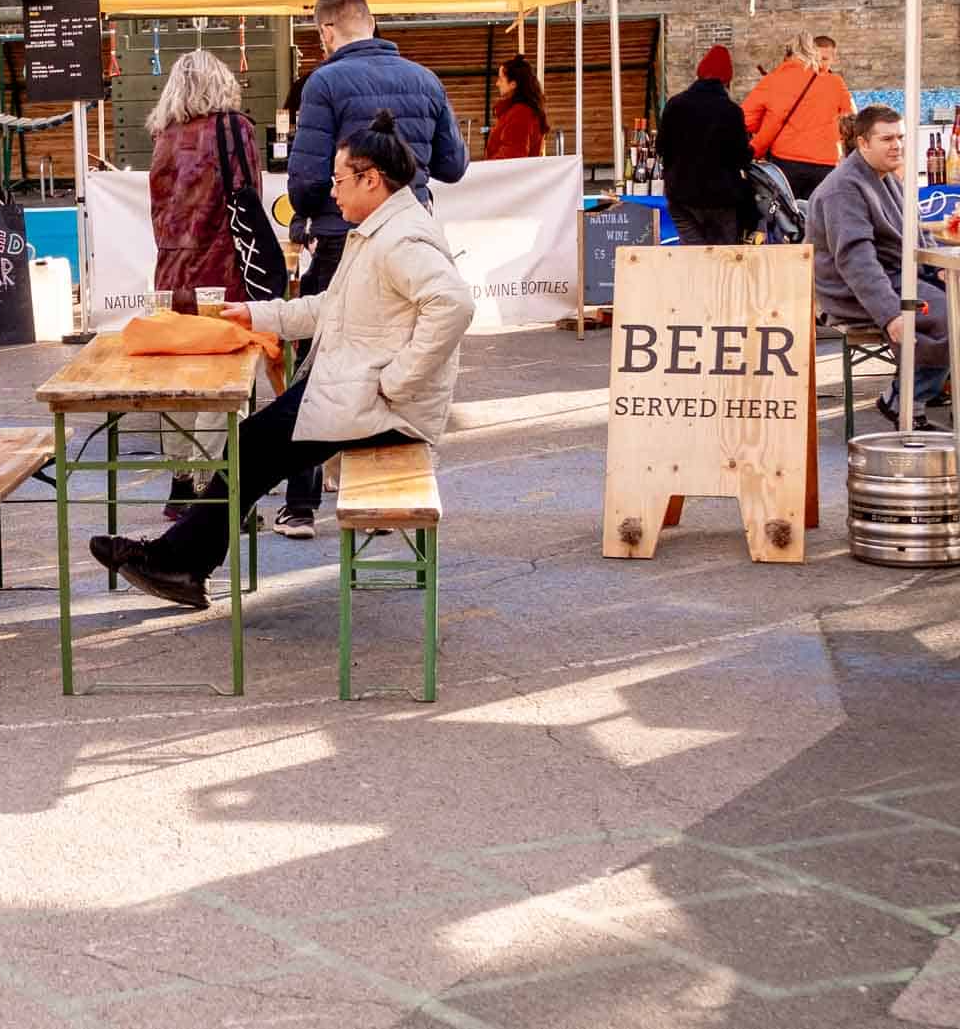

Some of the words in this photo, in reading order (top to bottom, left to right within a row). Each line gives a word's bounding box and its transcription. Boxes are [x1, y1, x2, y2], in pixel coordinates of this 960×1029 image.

[606, 229, 630, 241] WINE
[104, 295, 145, 310] NATUR
[485, 282, 518, 298] WINE
[520, 280, 569, 296] BOTTLES
[617, 324, 799, 377] BEER
[614, 396, 717, 418] SERVED
[725, 399, 797, 420] HERE
